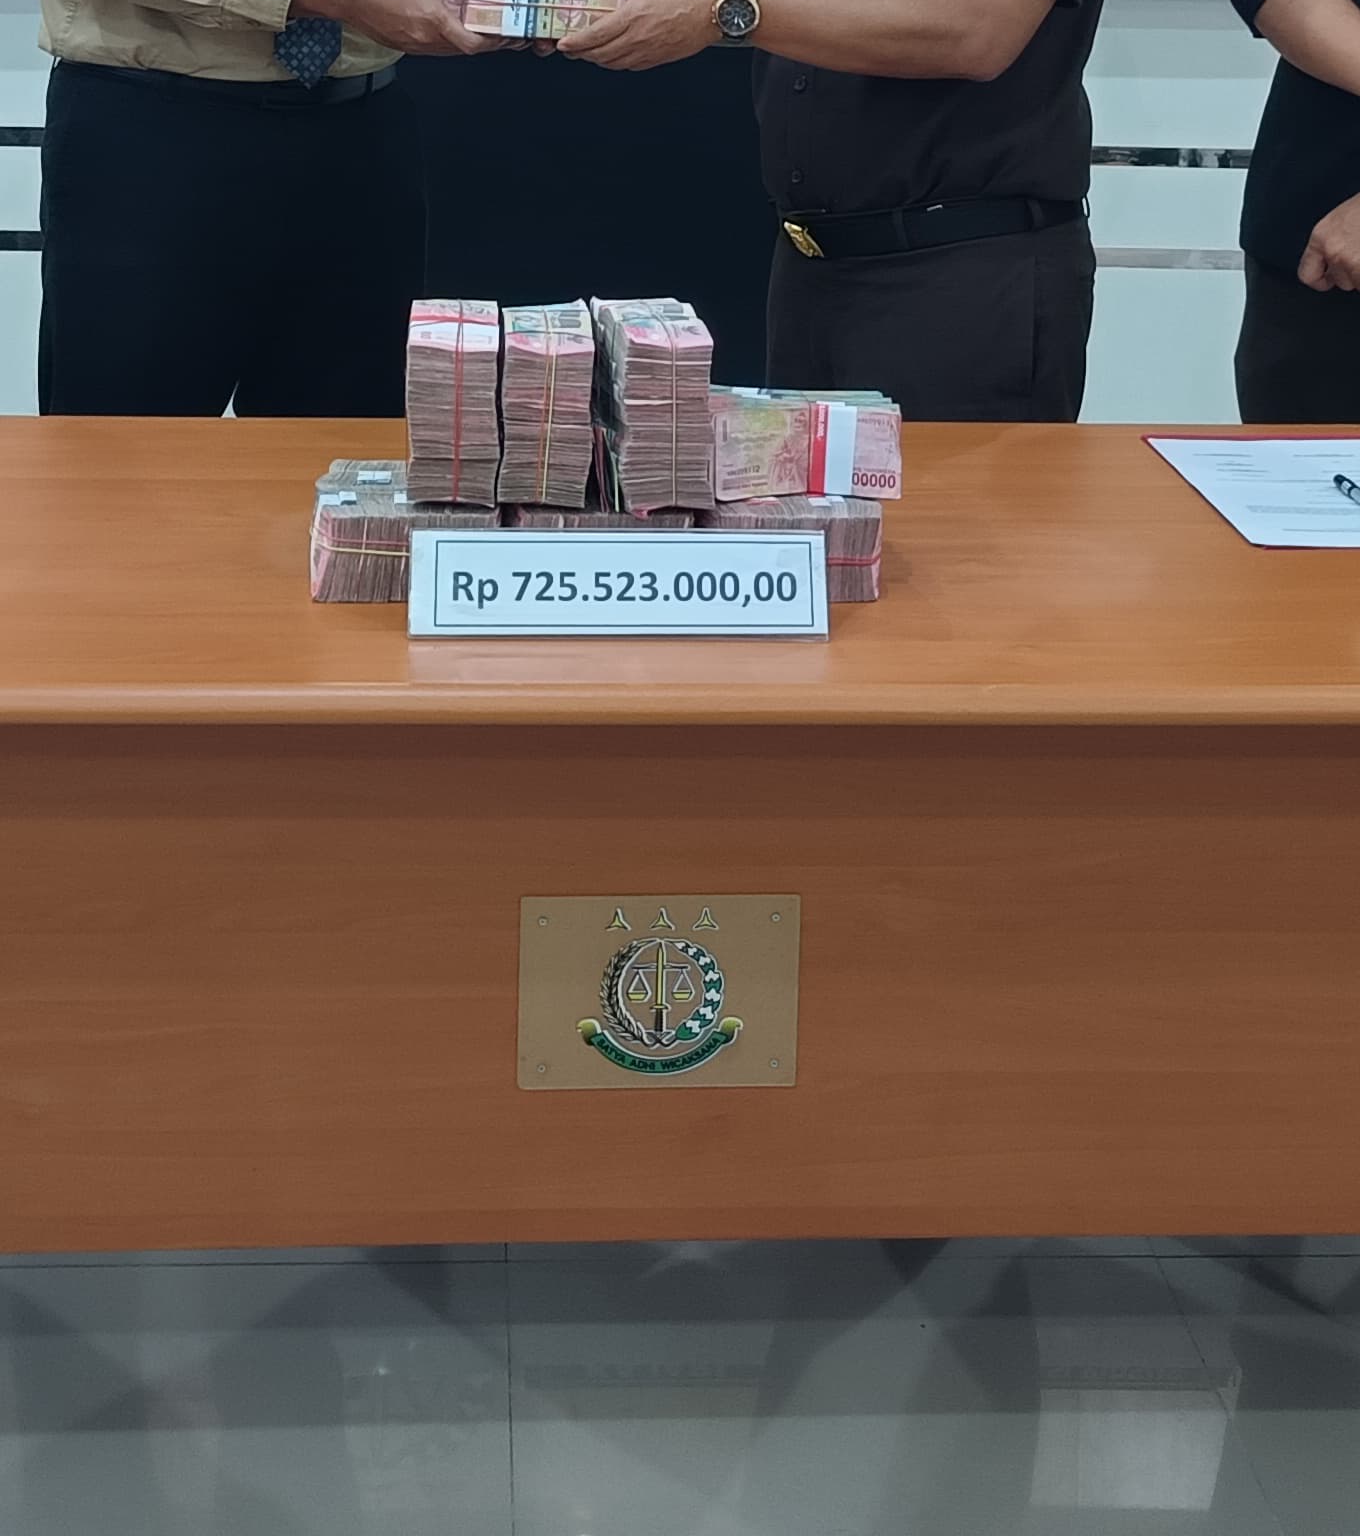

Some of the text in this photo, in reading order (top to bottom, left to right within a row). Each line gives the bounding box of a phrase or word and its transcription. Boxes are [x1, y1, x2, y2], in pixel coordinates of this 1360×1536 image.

[852, 472, 896, 489] 00000
[452, 570, 797, 609] Rp 725.523.000,00
[598, 1037, 723, 1070] SATYA ADHI WICAKSANA
